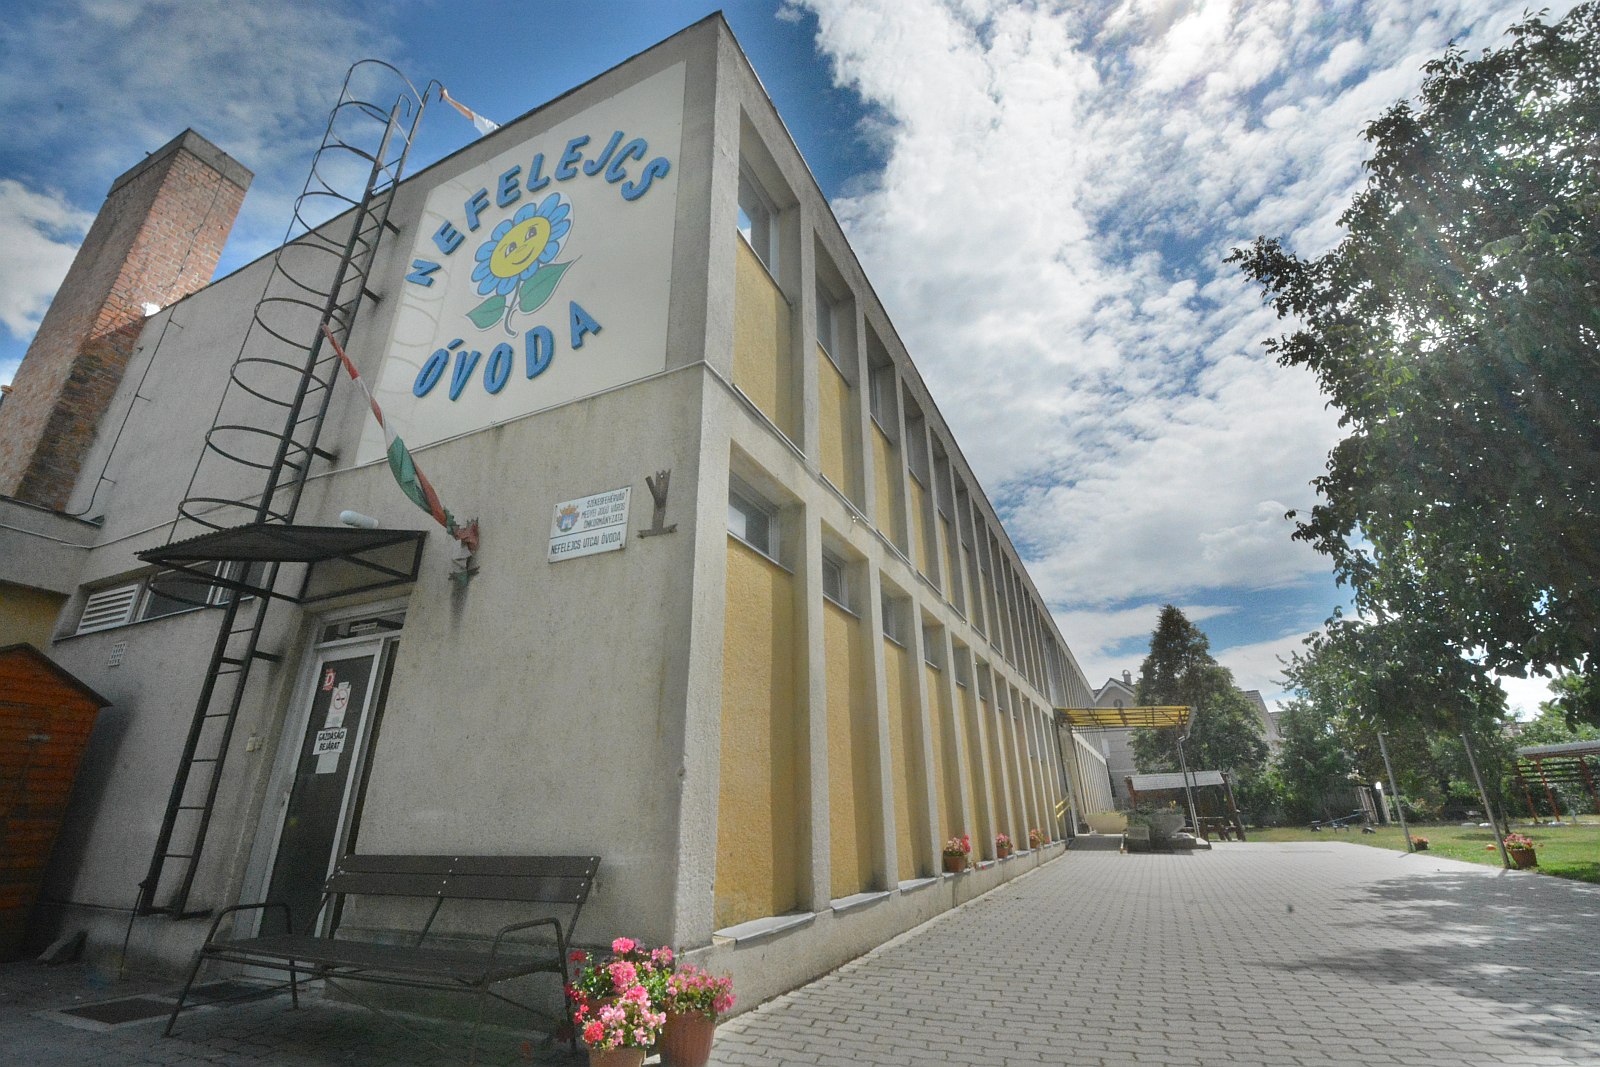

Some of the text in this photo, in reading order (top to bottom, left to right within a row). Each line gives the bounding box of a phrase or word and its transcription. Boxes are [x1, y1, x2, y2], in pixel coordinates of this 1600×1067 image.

[404, 130, 671, 287] NEFELEJCS
[412, 300, 603, 402] ÓVODA
[551, 539, 582, 555] NEFELEJCS
[583, 535, 599, 548] UTCAI
[318, 730, 345, 741] GAZDASÁGI
[319, 741, 341, 751] BEJÁRAT
